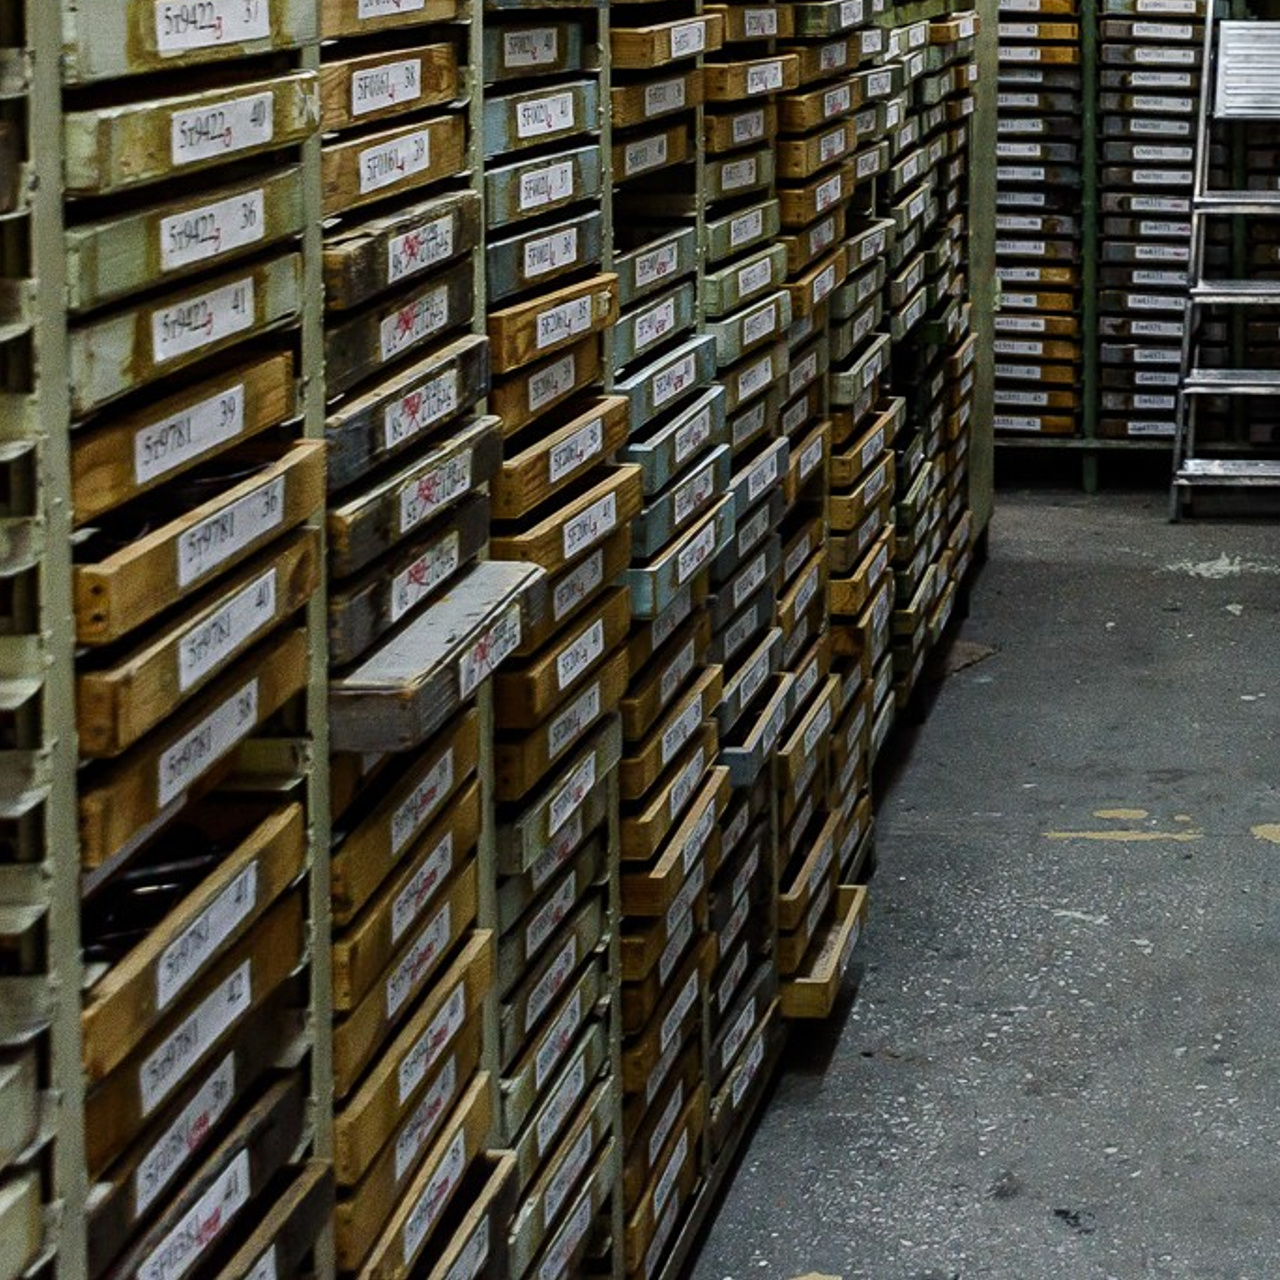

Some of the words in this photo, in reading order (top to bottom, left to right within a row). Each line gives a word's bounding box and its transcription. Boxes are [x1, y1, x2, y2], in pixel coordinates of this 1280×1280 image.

[250, 100, 265, 129] 40
[240, 199, 256, 230] 36
[231, 287, 245, 315] 41
